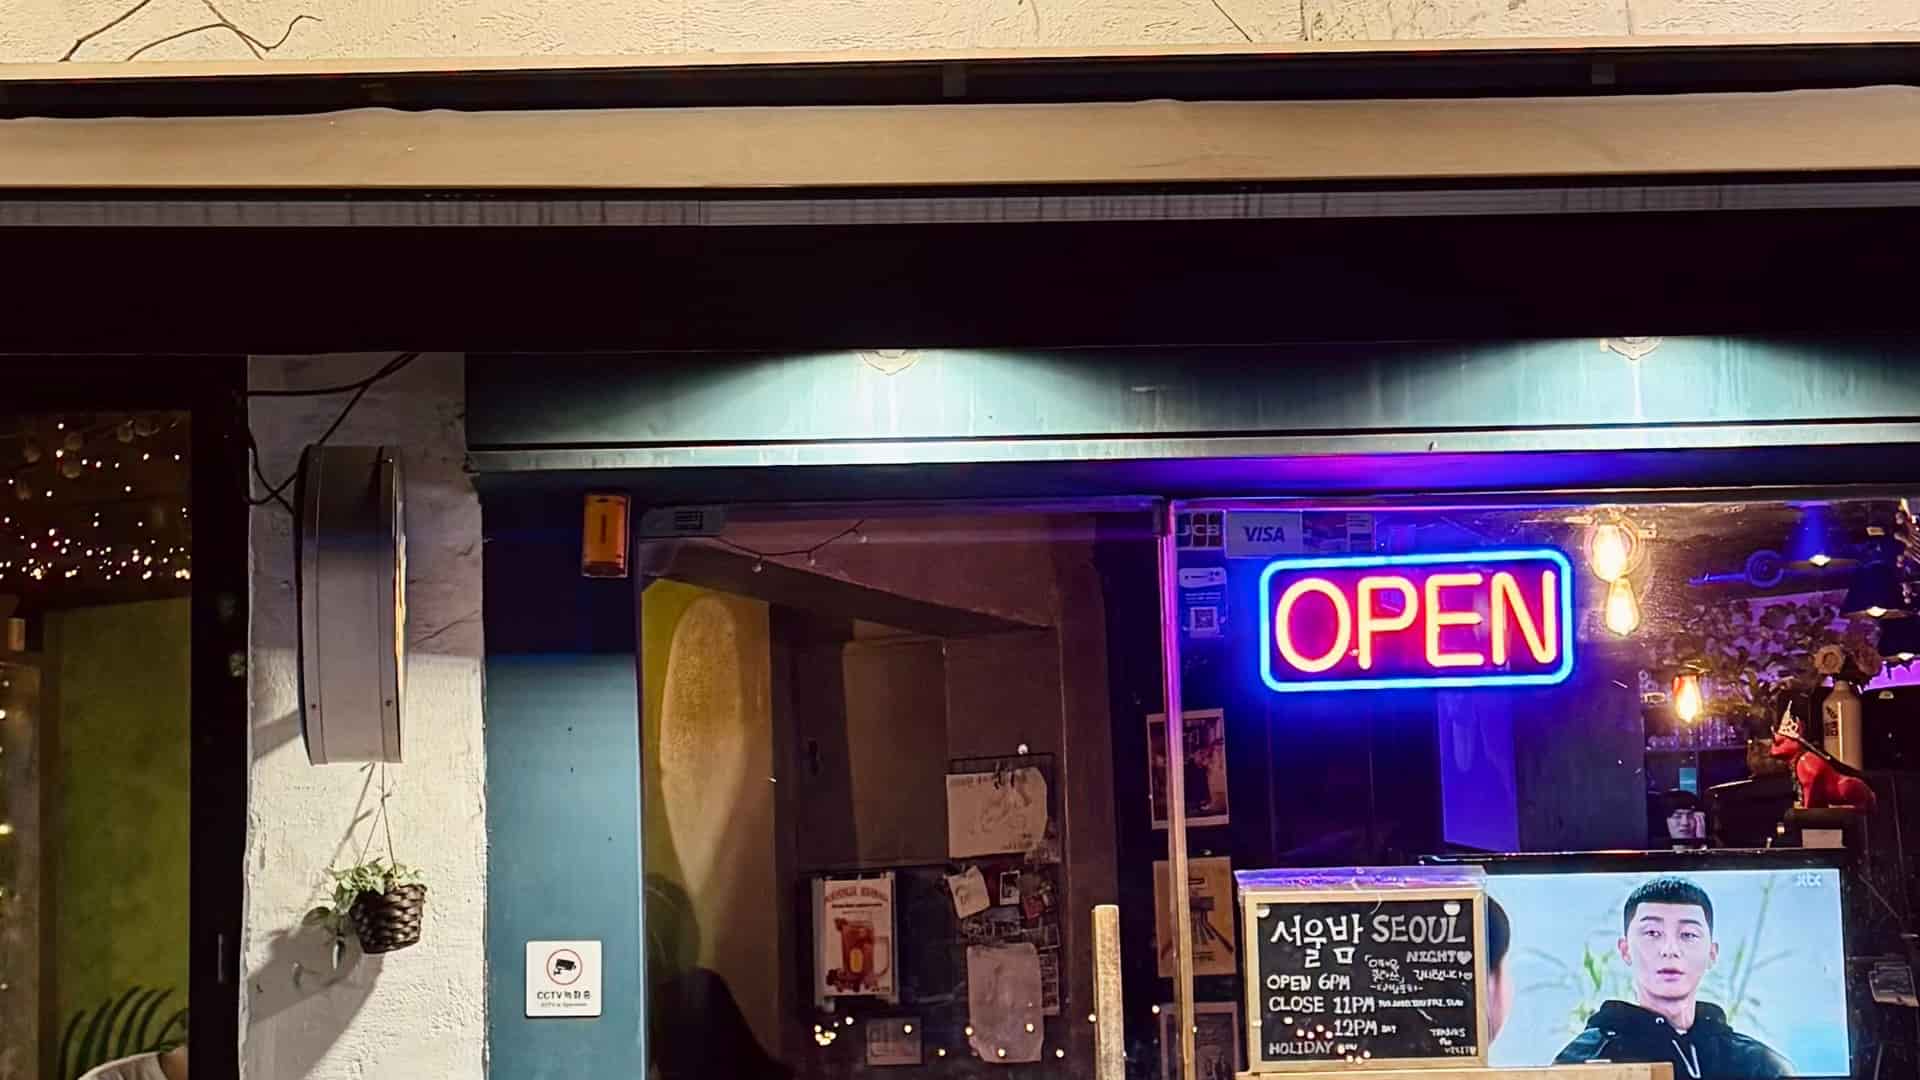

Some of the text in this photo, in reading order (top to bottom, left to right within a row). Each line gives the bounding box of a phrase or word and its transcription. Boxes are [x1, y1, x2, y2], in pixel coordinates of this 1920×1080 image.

[1243, 526, 1286, 542] VISA
[1274, 569, 1557, 675] OPEN
[1371, 914, 1466, 943] SEOUL
[1269, 913, 1364, 969] 서울밤
[1406, 950, 1457, 964] NIGHT
[1266, 973, 1351, 991] OPEN 6PM
[536, 991, 562, 1000] CCTV
[1268, 996, 1325, 1013] CLOSE
[1333, 996, 1375, 1014] 11PM
[1334, 1018, 1378, 1036] 12PM
[1268, 1040, 1335, 1055] HOLIDAY
